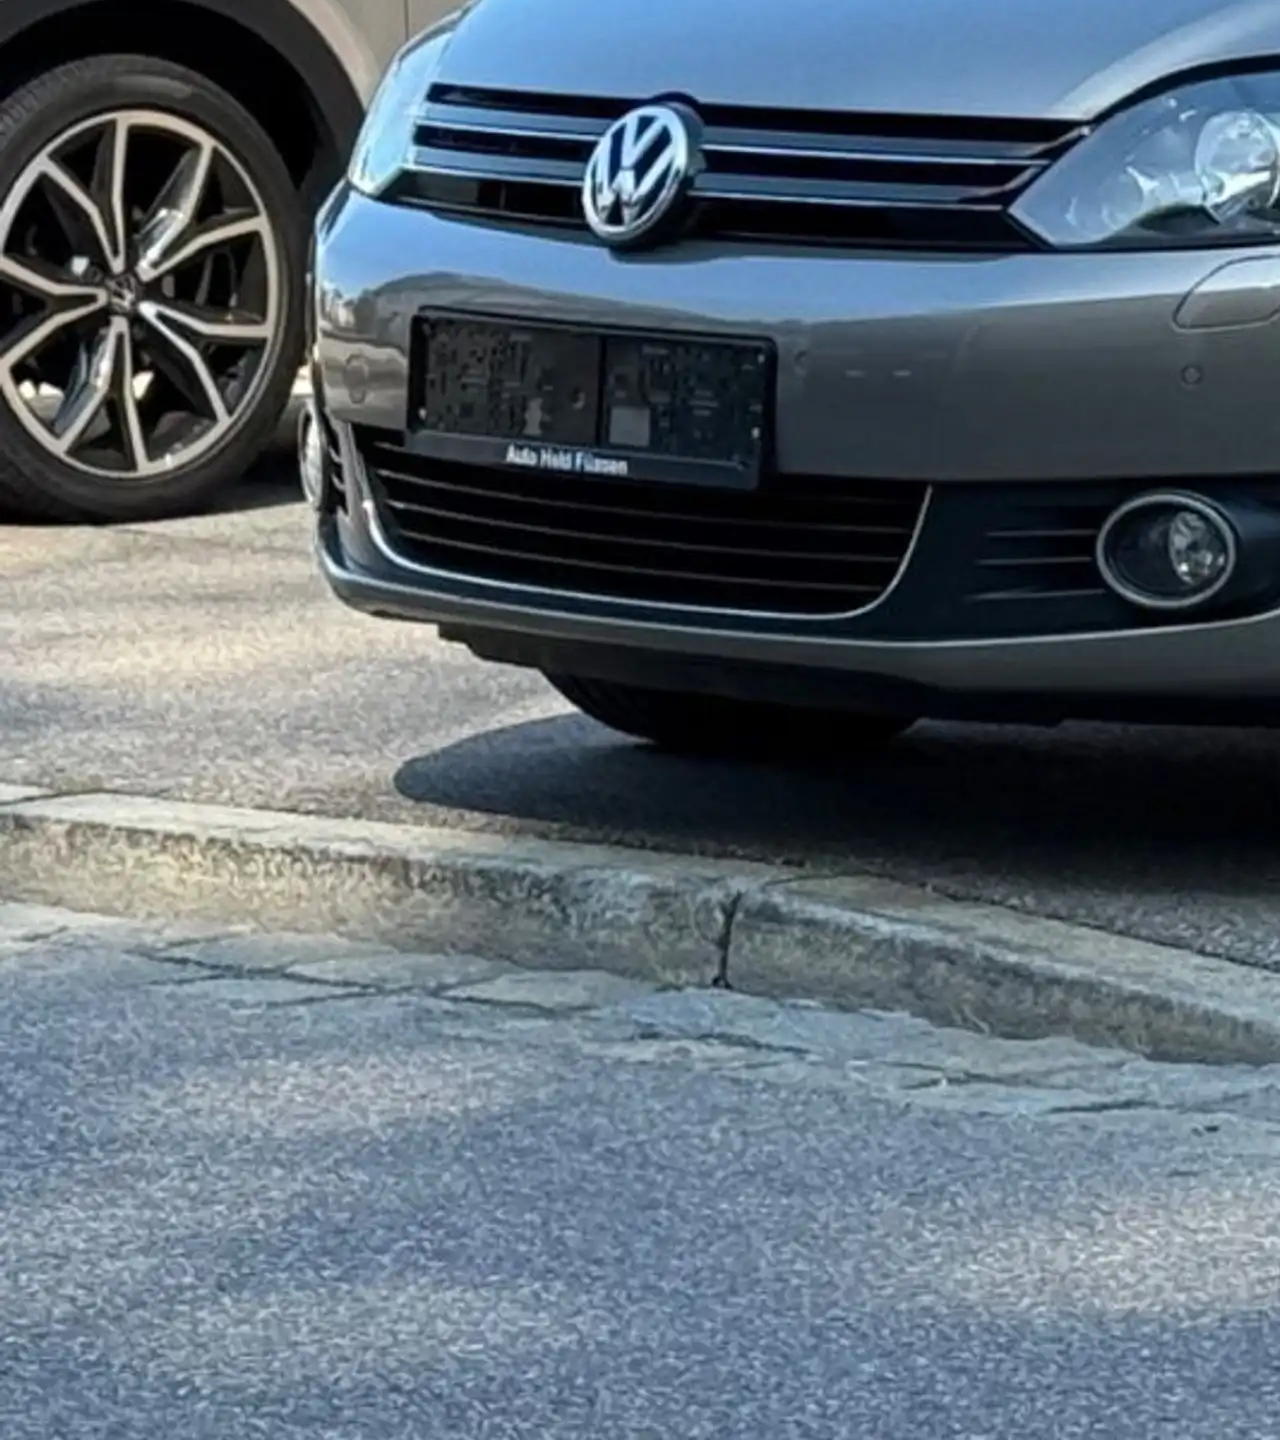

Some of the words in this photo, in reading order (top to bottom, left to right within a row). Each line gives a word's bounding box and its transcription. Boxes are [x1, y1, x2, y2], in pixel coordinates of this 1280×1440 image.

[506, 442, 538, 466] Auto
[540, 447, 573, 472] Held
[575, 450, 629, 477] Füssen
